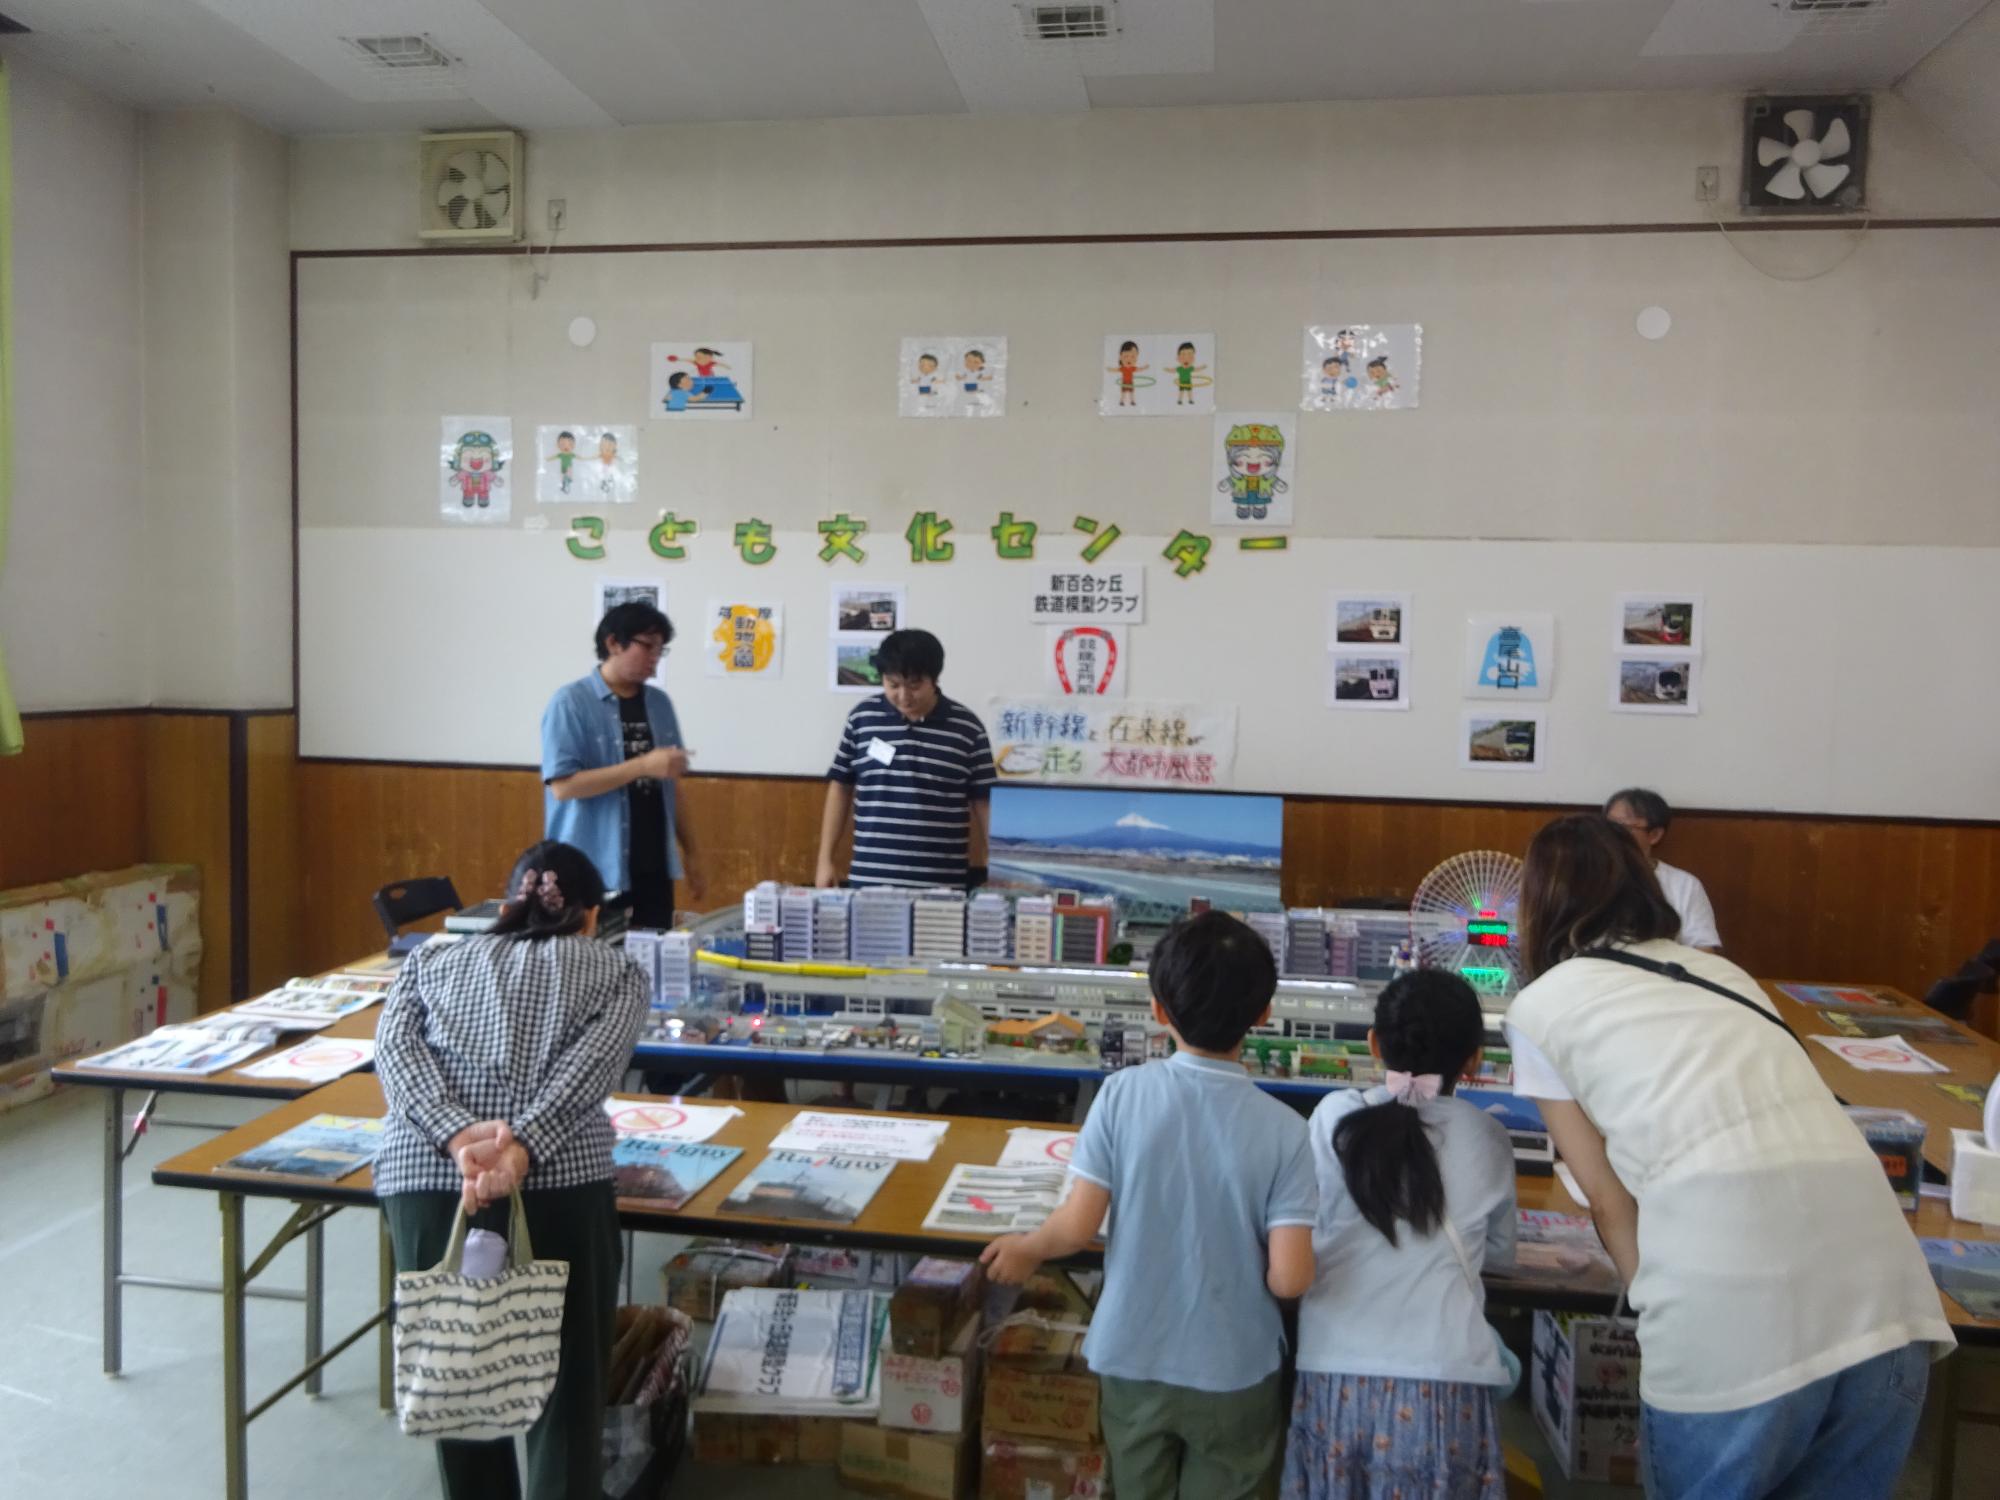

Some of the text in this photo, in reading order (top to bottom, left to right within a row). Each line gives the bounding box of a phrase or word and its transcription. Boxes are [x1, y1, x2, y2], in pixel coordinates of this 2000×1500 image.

[1050, 574, 1123, 592] 新百合ヶ丘
[1034, 595, 1139, 613] 鉄道模型クラブ
